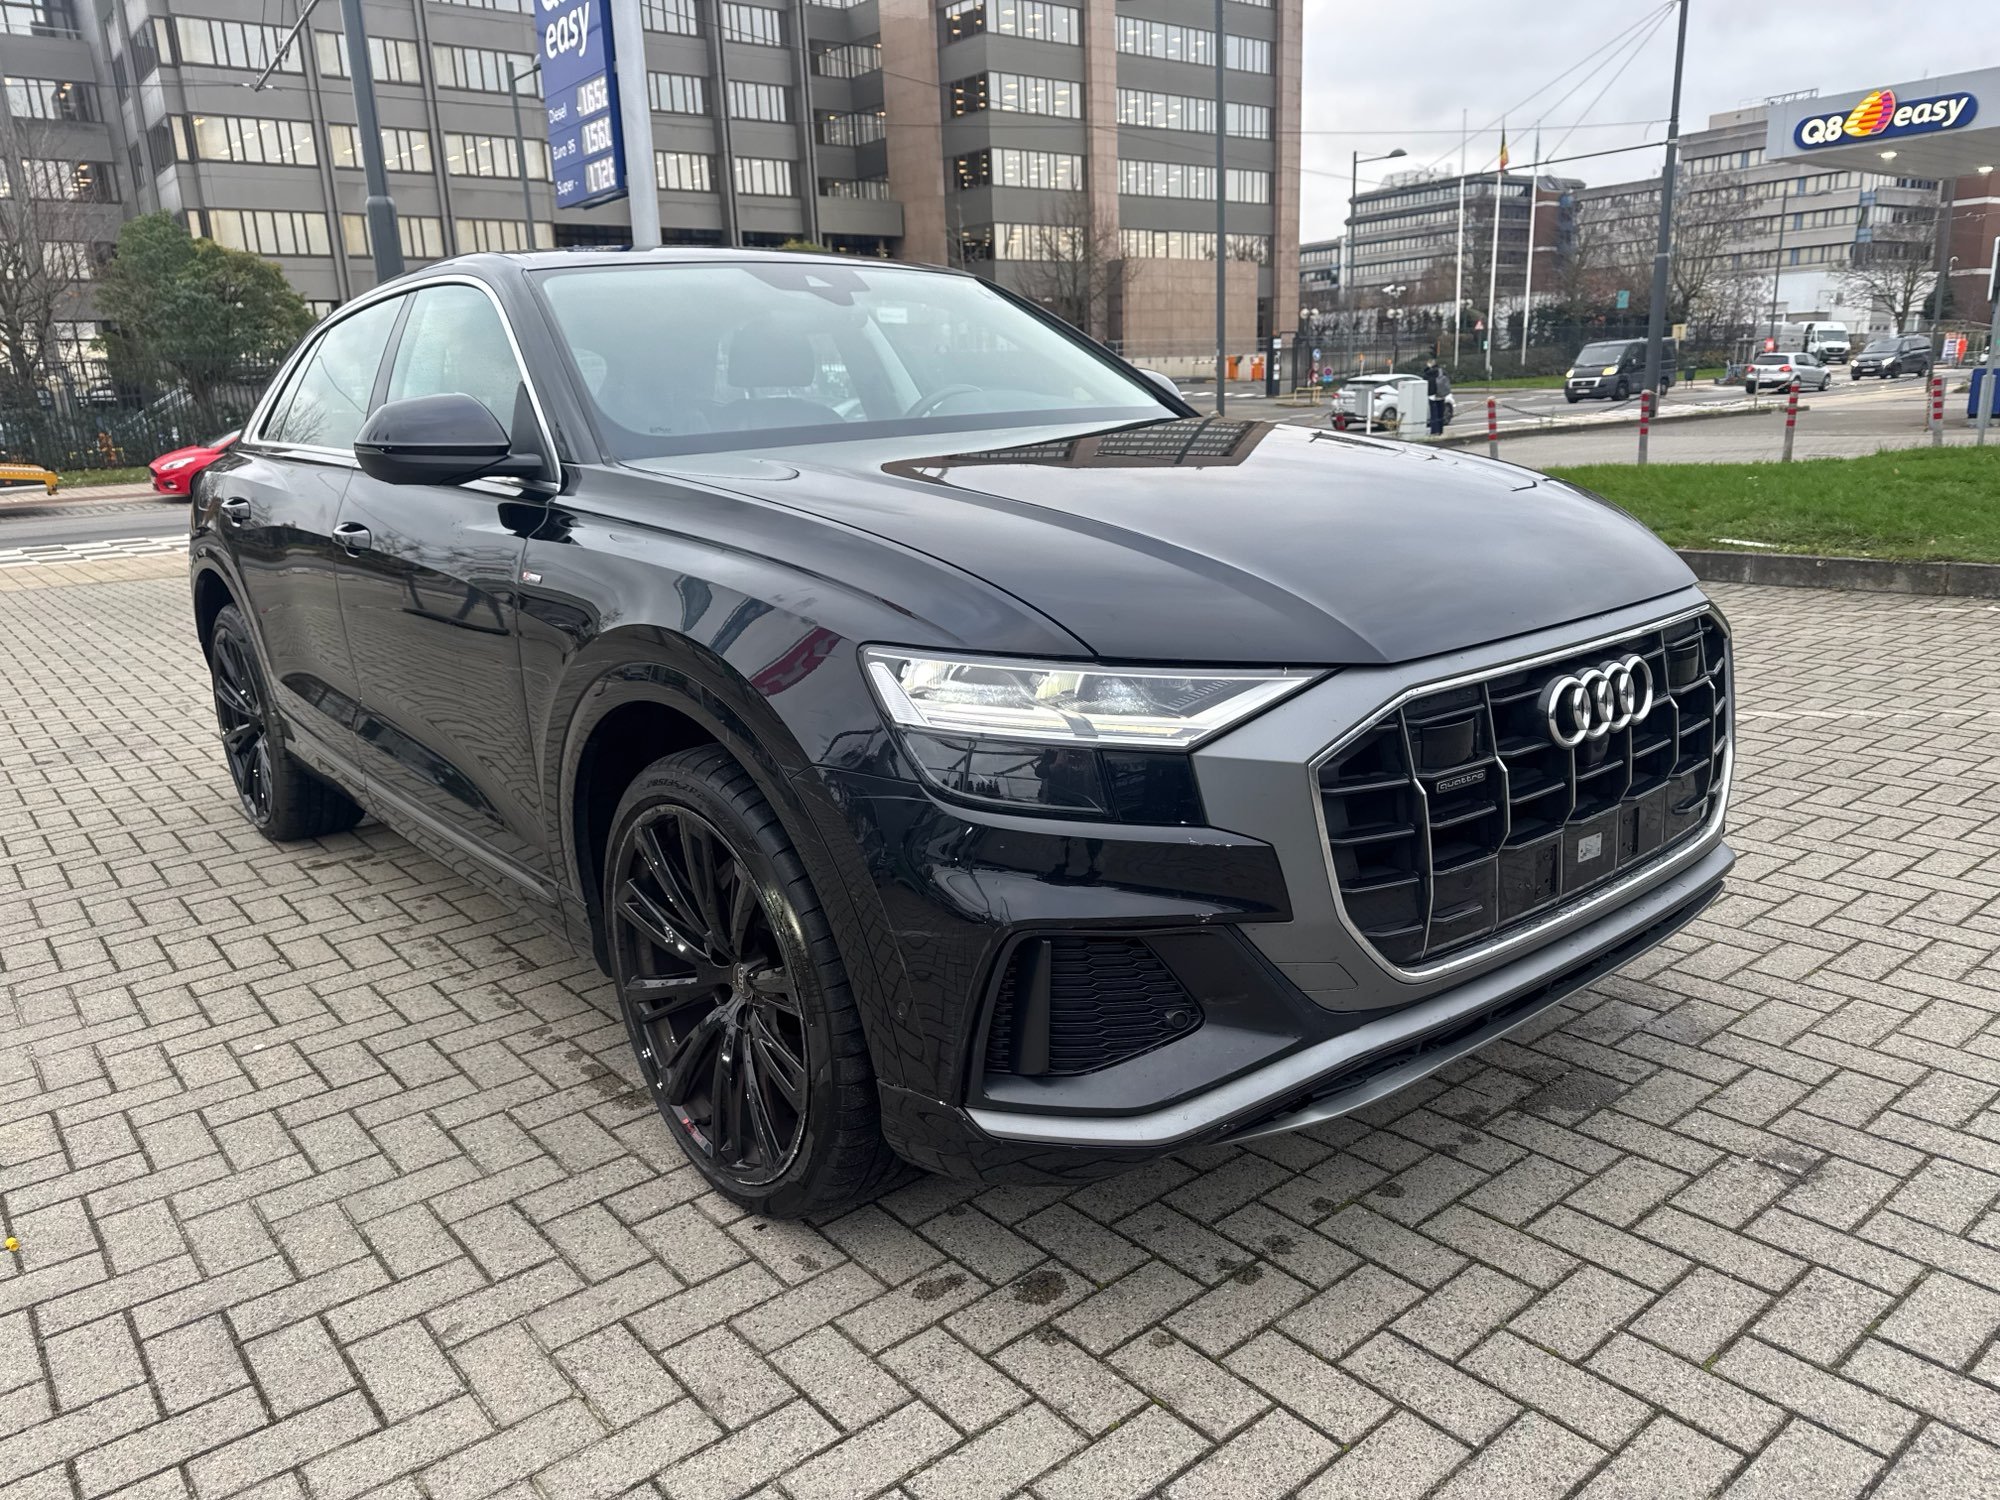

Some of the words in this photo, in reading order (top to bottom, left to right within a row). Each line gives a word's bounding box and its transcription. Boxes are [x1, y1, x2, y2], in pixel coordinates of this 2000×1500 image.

[545, 1, 590, 59] easy
[549, 101, 567, 124] Diesel
[1801, 115, 1843, 145] Q8
[1893, 97, 1968, 127] easy
[553, 146, 567, 160] Euro
[567, 138, 576, 155] 95
[557, 179, 575, 196] Super
[1440, 772, 1484, 790] quattro
